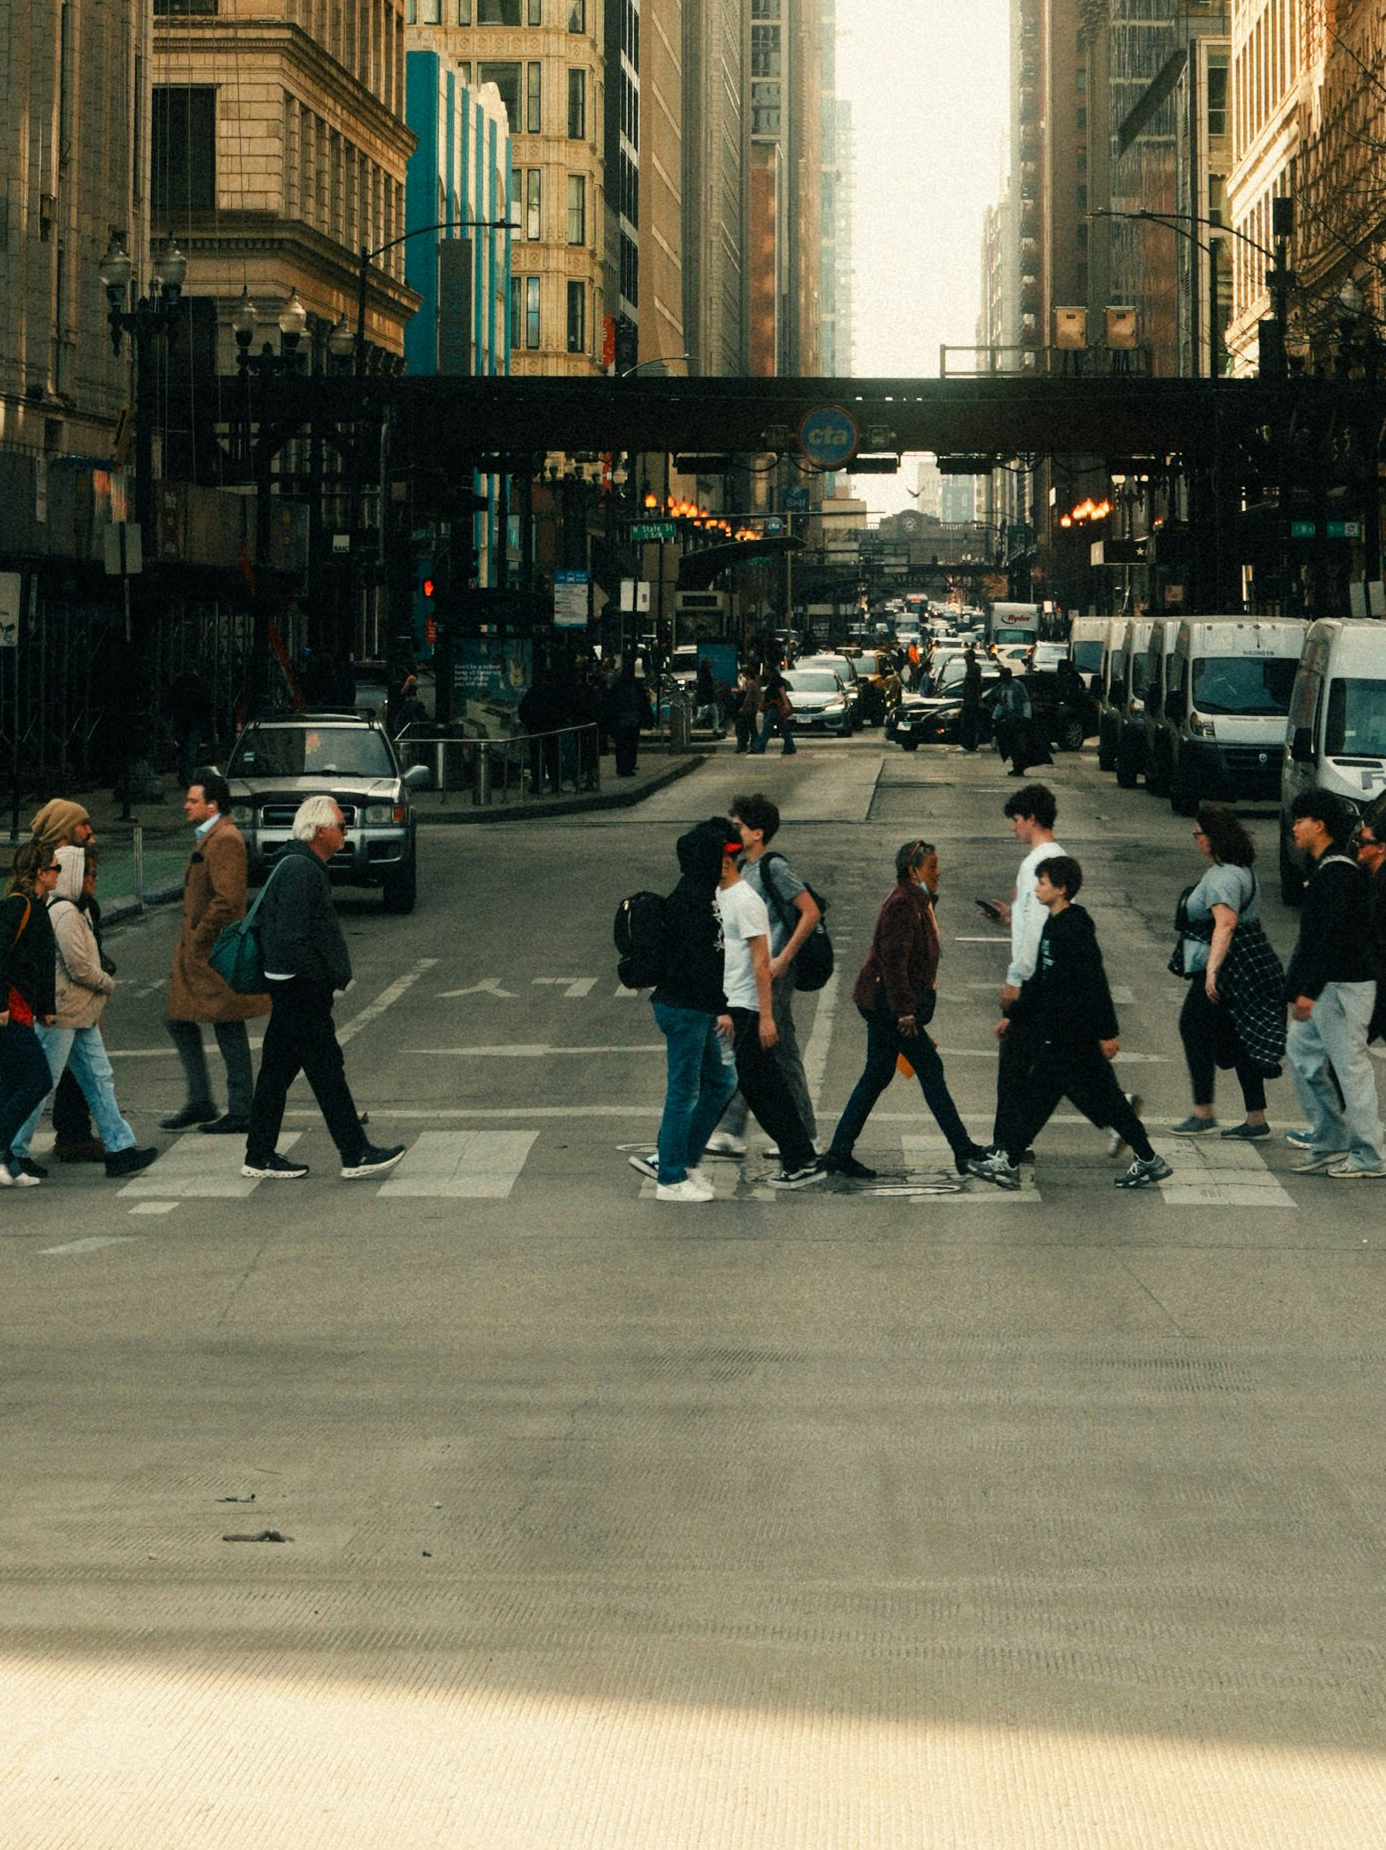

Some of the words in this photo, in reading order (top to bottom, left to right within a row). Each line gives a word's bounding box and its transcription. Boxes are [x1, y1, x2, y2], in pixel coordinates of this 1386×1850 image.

[807, 426, 849, 446] cta
[642, 524, 662, 533] State
[665, 523, 673, 532] St
[1008, 615, 1031, 623] Ryder
